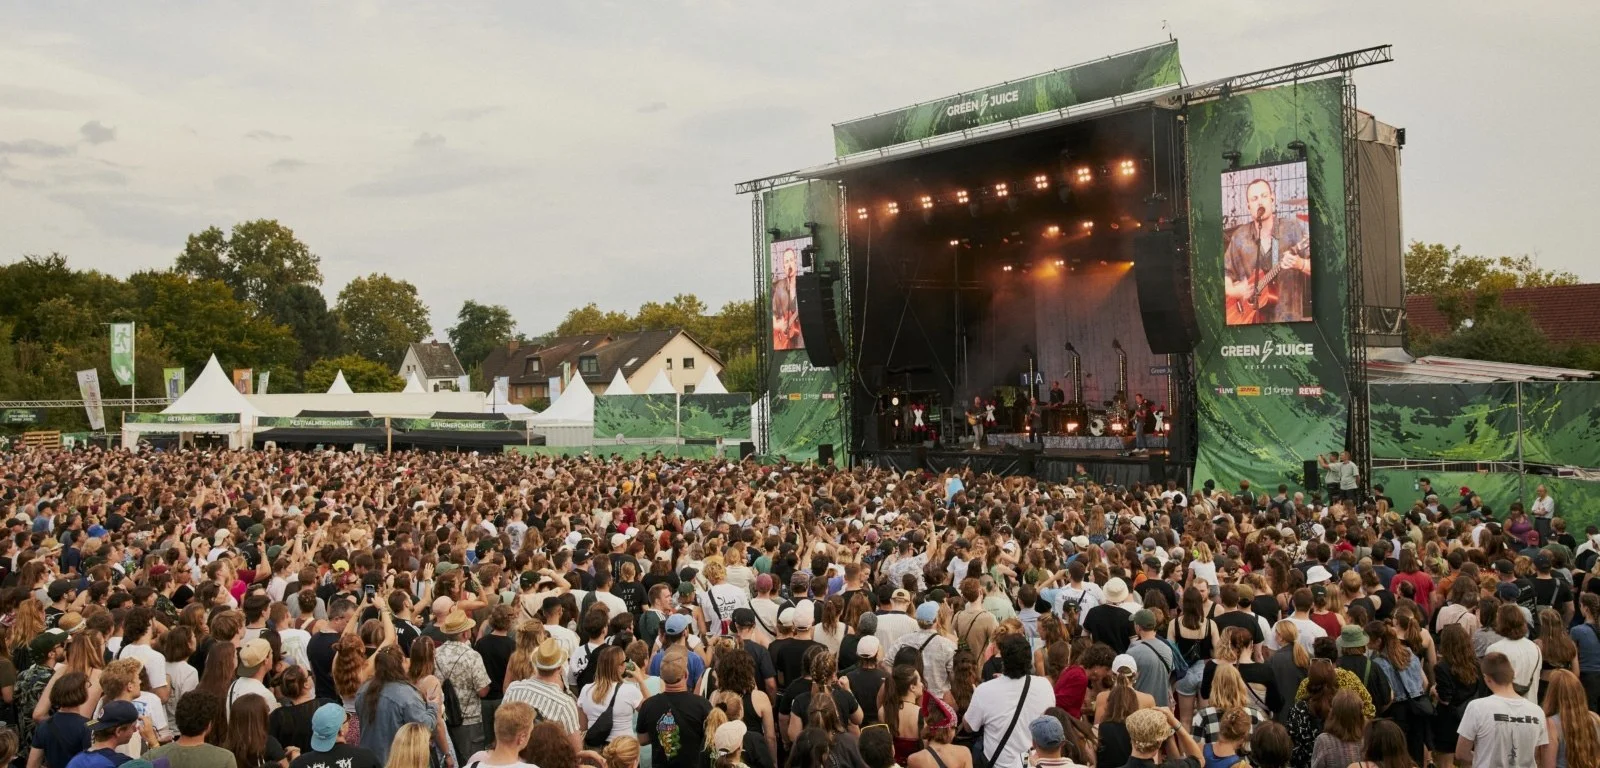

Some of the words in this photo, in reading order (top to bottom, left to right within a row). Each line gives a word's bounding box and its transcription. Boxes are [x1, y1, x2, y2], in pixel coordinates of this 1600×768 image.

[947, 100, 979, 117] GREEN
[990, 90, 1019, 107] JUICE
[1221, 345, 1260, 356] GREEN
[1275, 344, 1314, 355] JUICE
[780, 364, 801, 372] GREEN
[1023, 373, 1028, 385] 1
[1035, 372, 1043, 385] A
[1298, 387, 1322, 395] REWE
[1493, 713, 1540, 725] Exit
